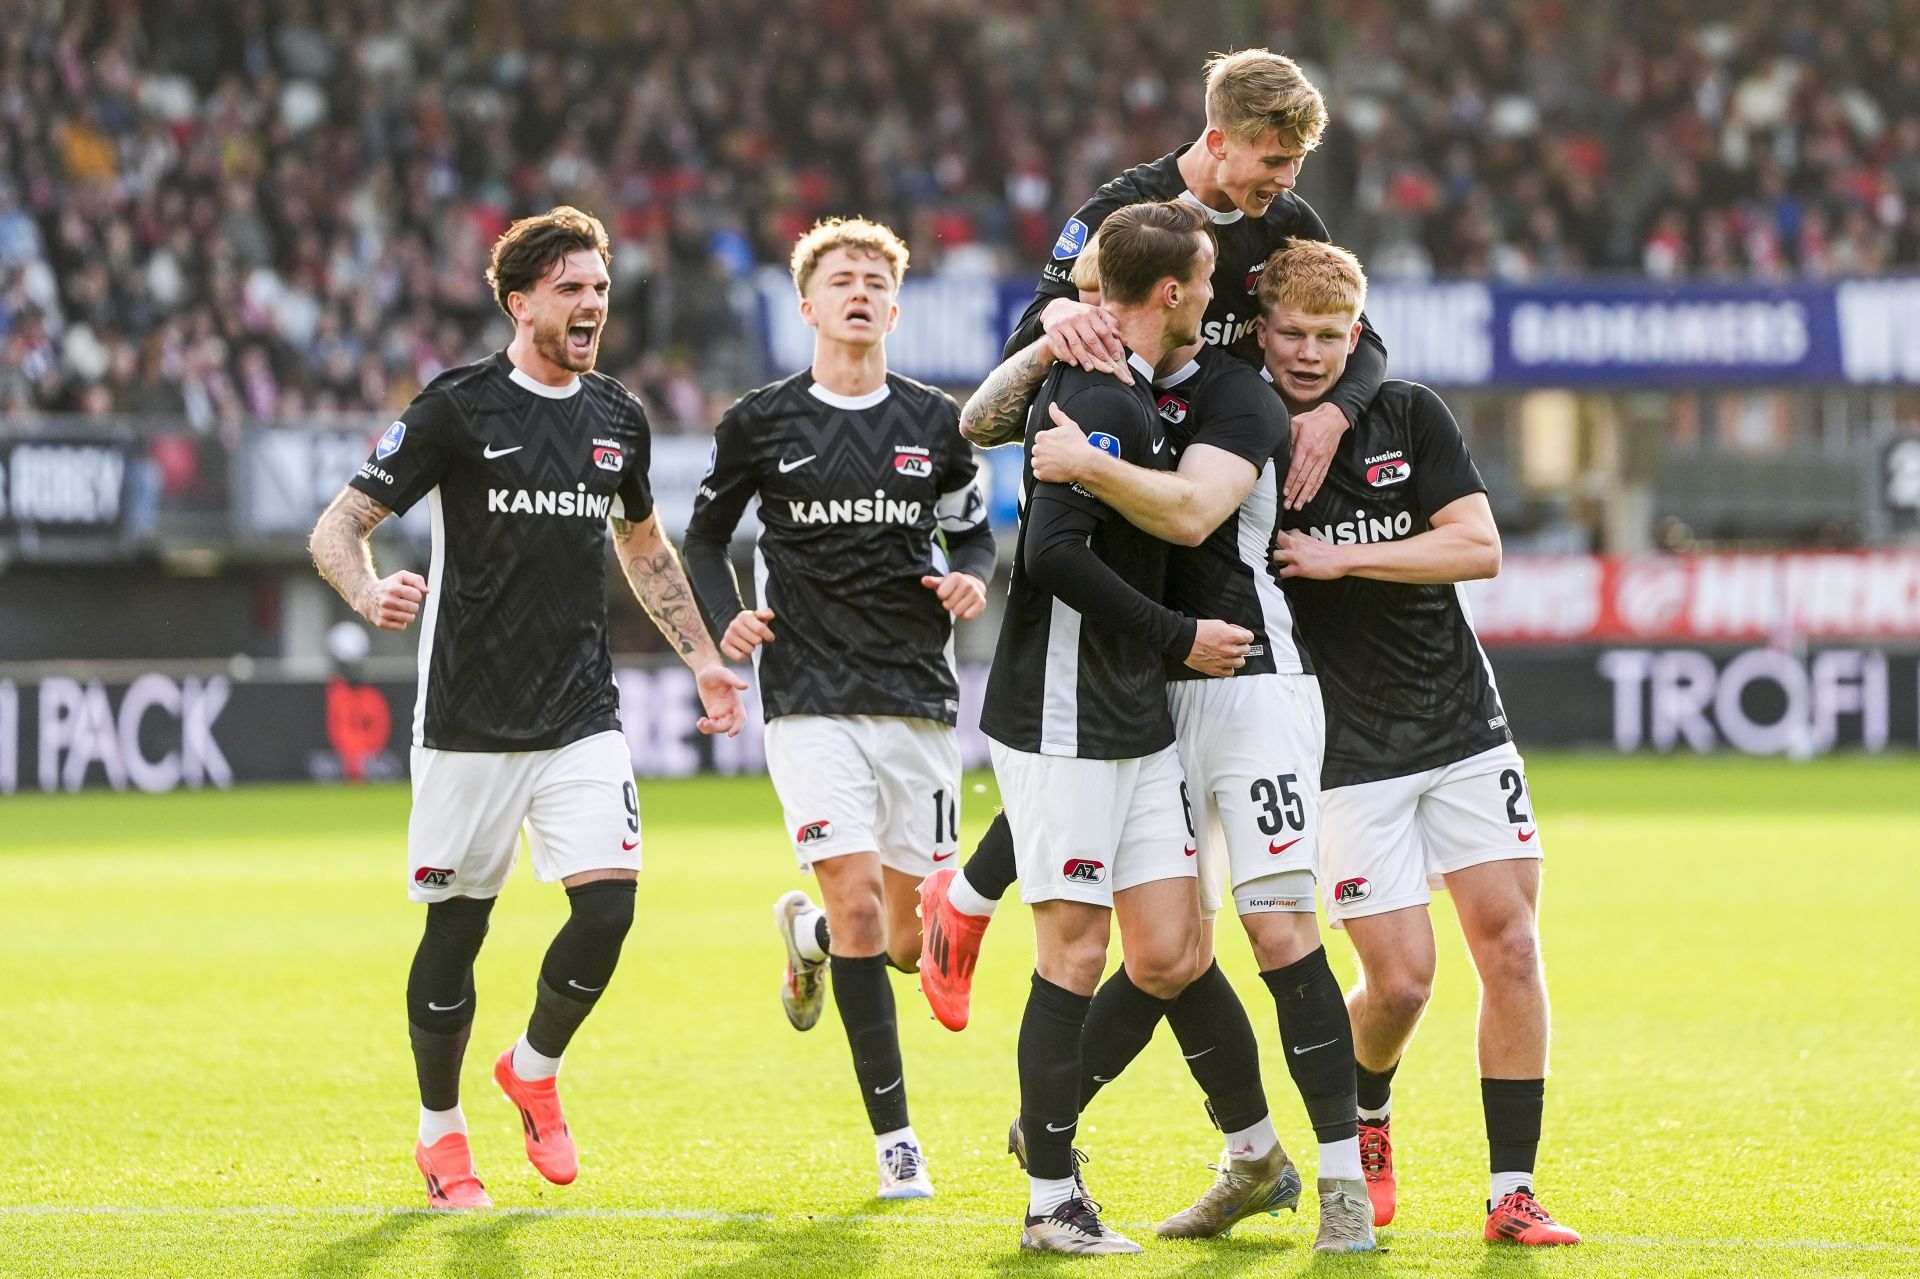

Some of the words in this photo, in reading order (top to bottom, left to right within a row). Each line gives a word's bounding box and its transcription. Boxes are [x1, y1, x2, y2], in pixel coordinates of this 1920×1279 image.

[1375, 463, 1406, 485] AZ
[1600, 647, 1890, 756] TROFI
[38, 672, 234, 794] PACK
[622, 781, 639, 834] 9
[1250, 773, 1305, 836] 35
[803, 825, 827, 843] AZ
[423, 871, 449, 886] AZ
[1070, 862, 1099, 881] AZ
[1340, 881, 1366, 902] AZ
